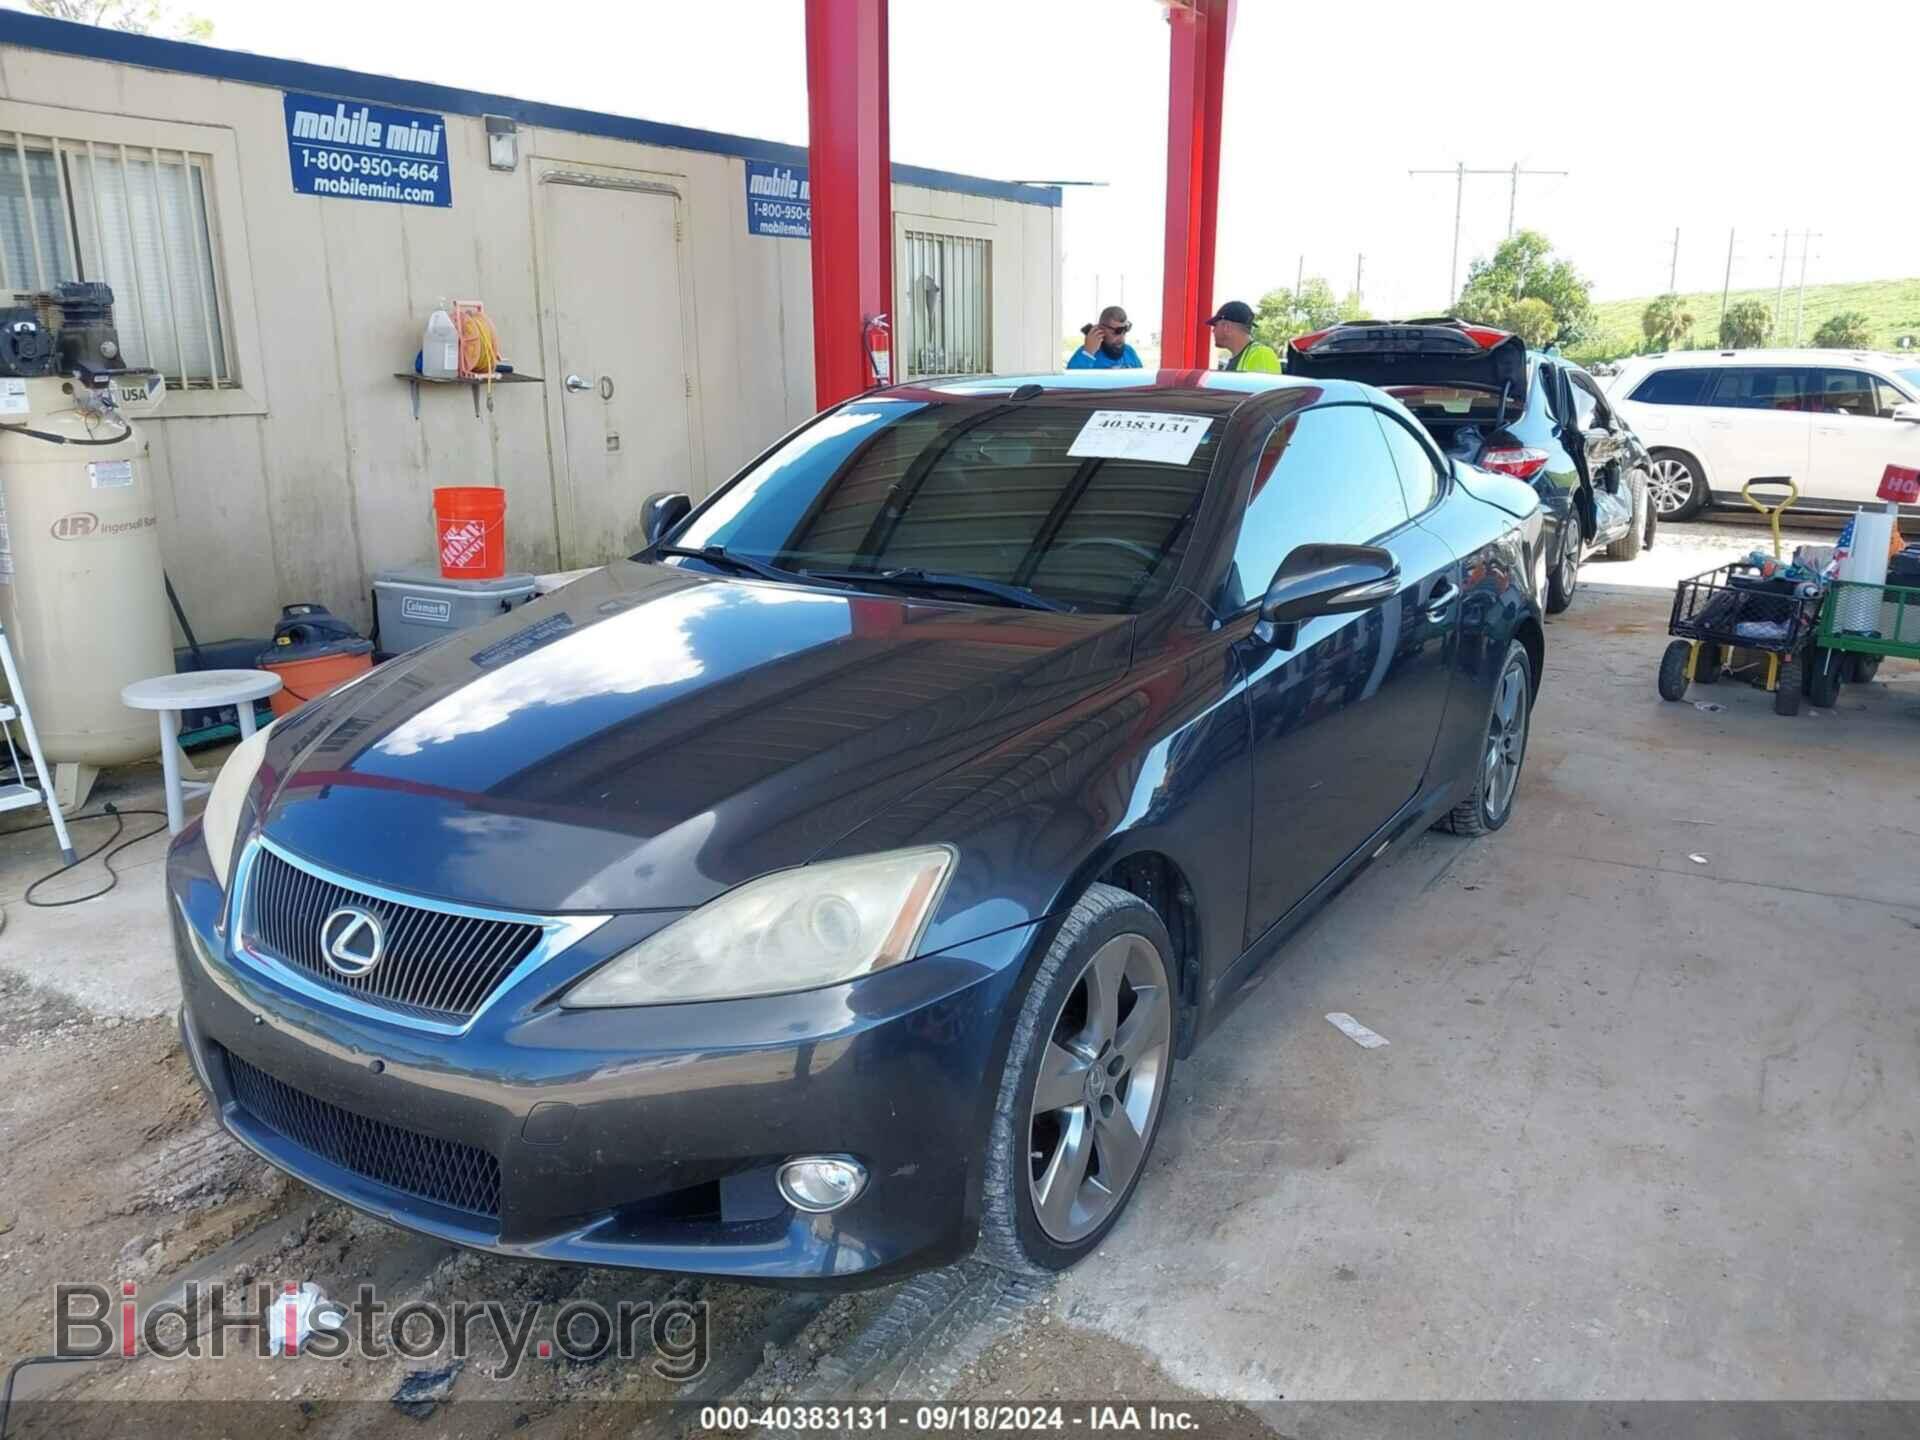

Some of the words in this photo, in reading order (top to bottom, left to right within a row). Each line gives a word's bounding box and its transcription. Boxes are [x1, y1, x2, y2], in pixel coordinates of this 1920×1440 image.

[293, 104, 382, 147] mobile
[386, 121, 440, 155] mini
[302, 149, 439, 182] 1-800-950-6464
[314, 177, 434, 202] mobilemini.com
[750, 168, 798, 199] mobile
[122, 388, 148, 401] USA
[1098, 419, 1189, 433] 40383131
[442, 521, 483, 567] HOME
[456, 541, 484, 567] DEPOT
[406, 600, 439, 615] Coleman
